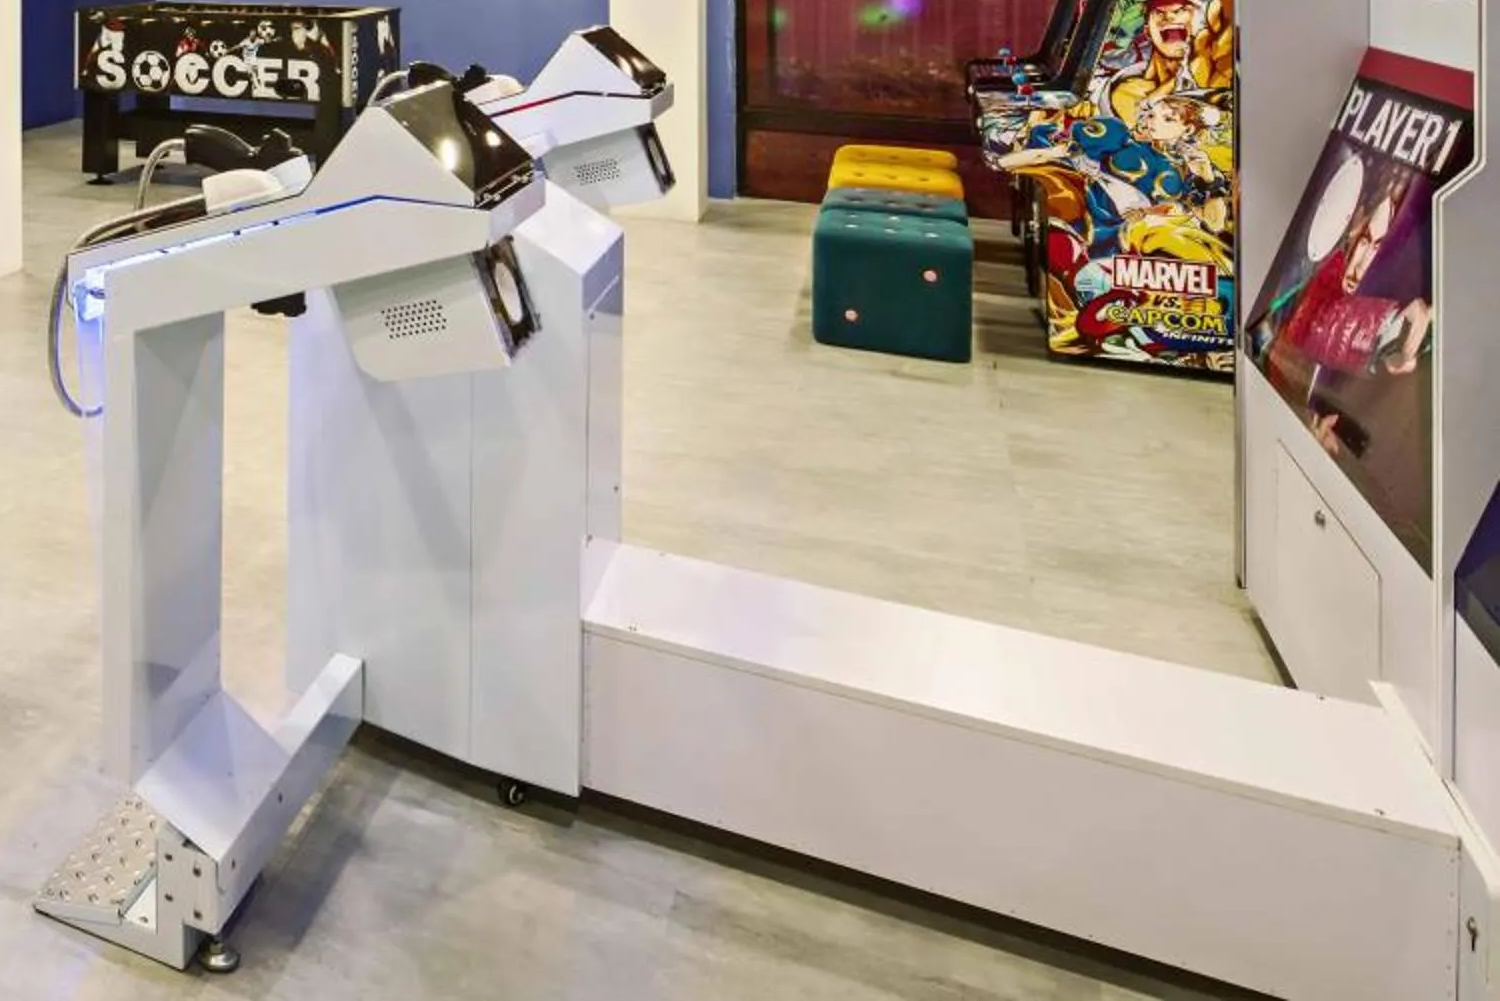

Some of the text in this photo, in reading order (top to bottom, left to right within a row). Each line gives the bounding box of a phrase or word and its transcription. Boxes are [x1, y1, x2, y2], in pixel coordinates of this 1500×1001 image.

[96, 49, 321, 102] SOCCER
[1338, 84, 1463, 175] PLAYER 1
[1115, 258, 1213, 295] MARVEL
[1107, 305, 1226, 334] CAPCOM
